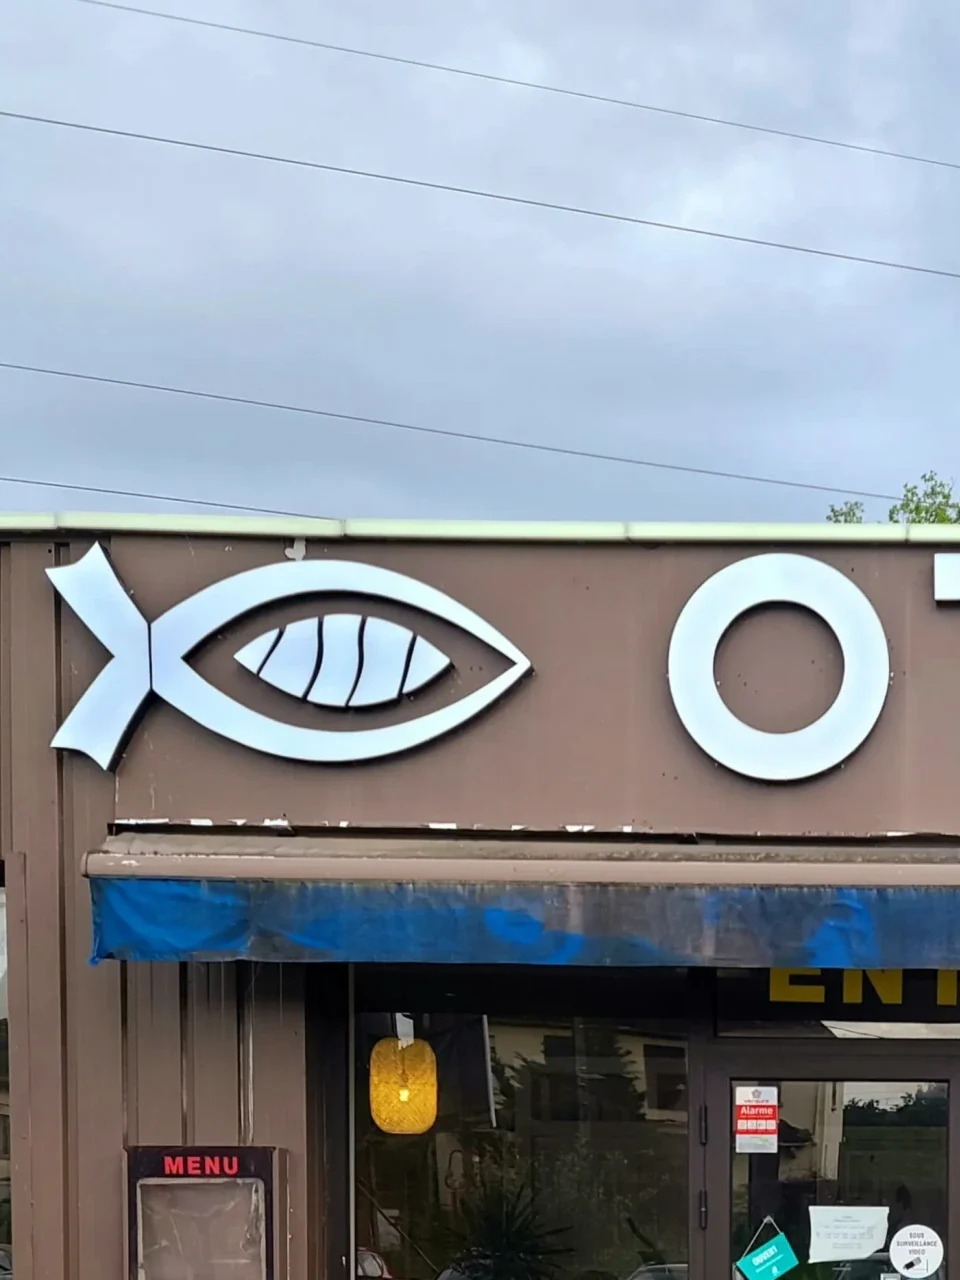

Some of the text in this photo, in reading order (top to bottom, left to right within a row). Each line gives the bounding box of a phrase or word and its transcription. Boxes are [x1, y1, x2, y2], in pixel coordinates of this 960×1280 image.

[740, 1105, 774, 1116] Alarme
[163, 1155, 240, 1176] MENU
[896, 1240, 938, 1248] SURVEILLANCE
